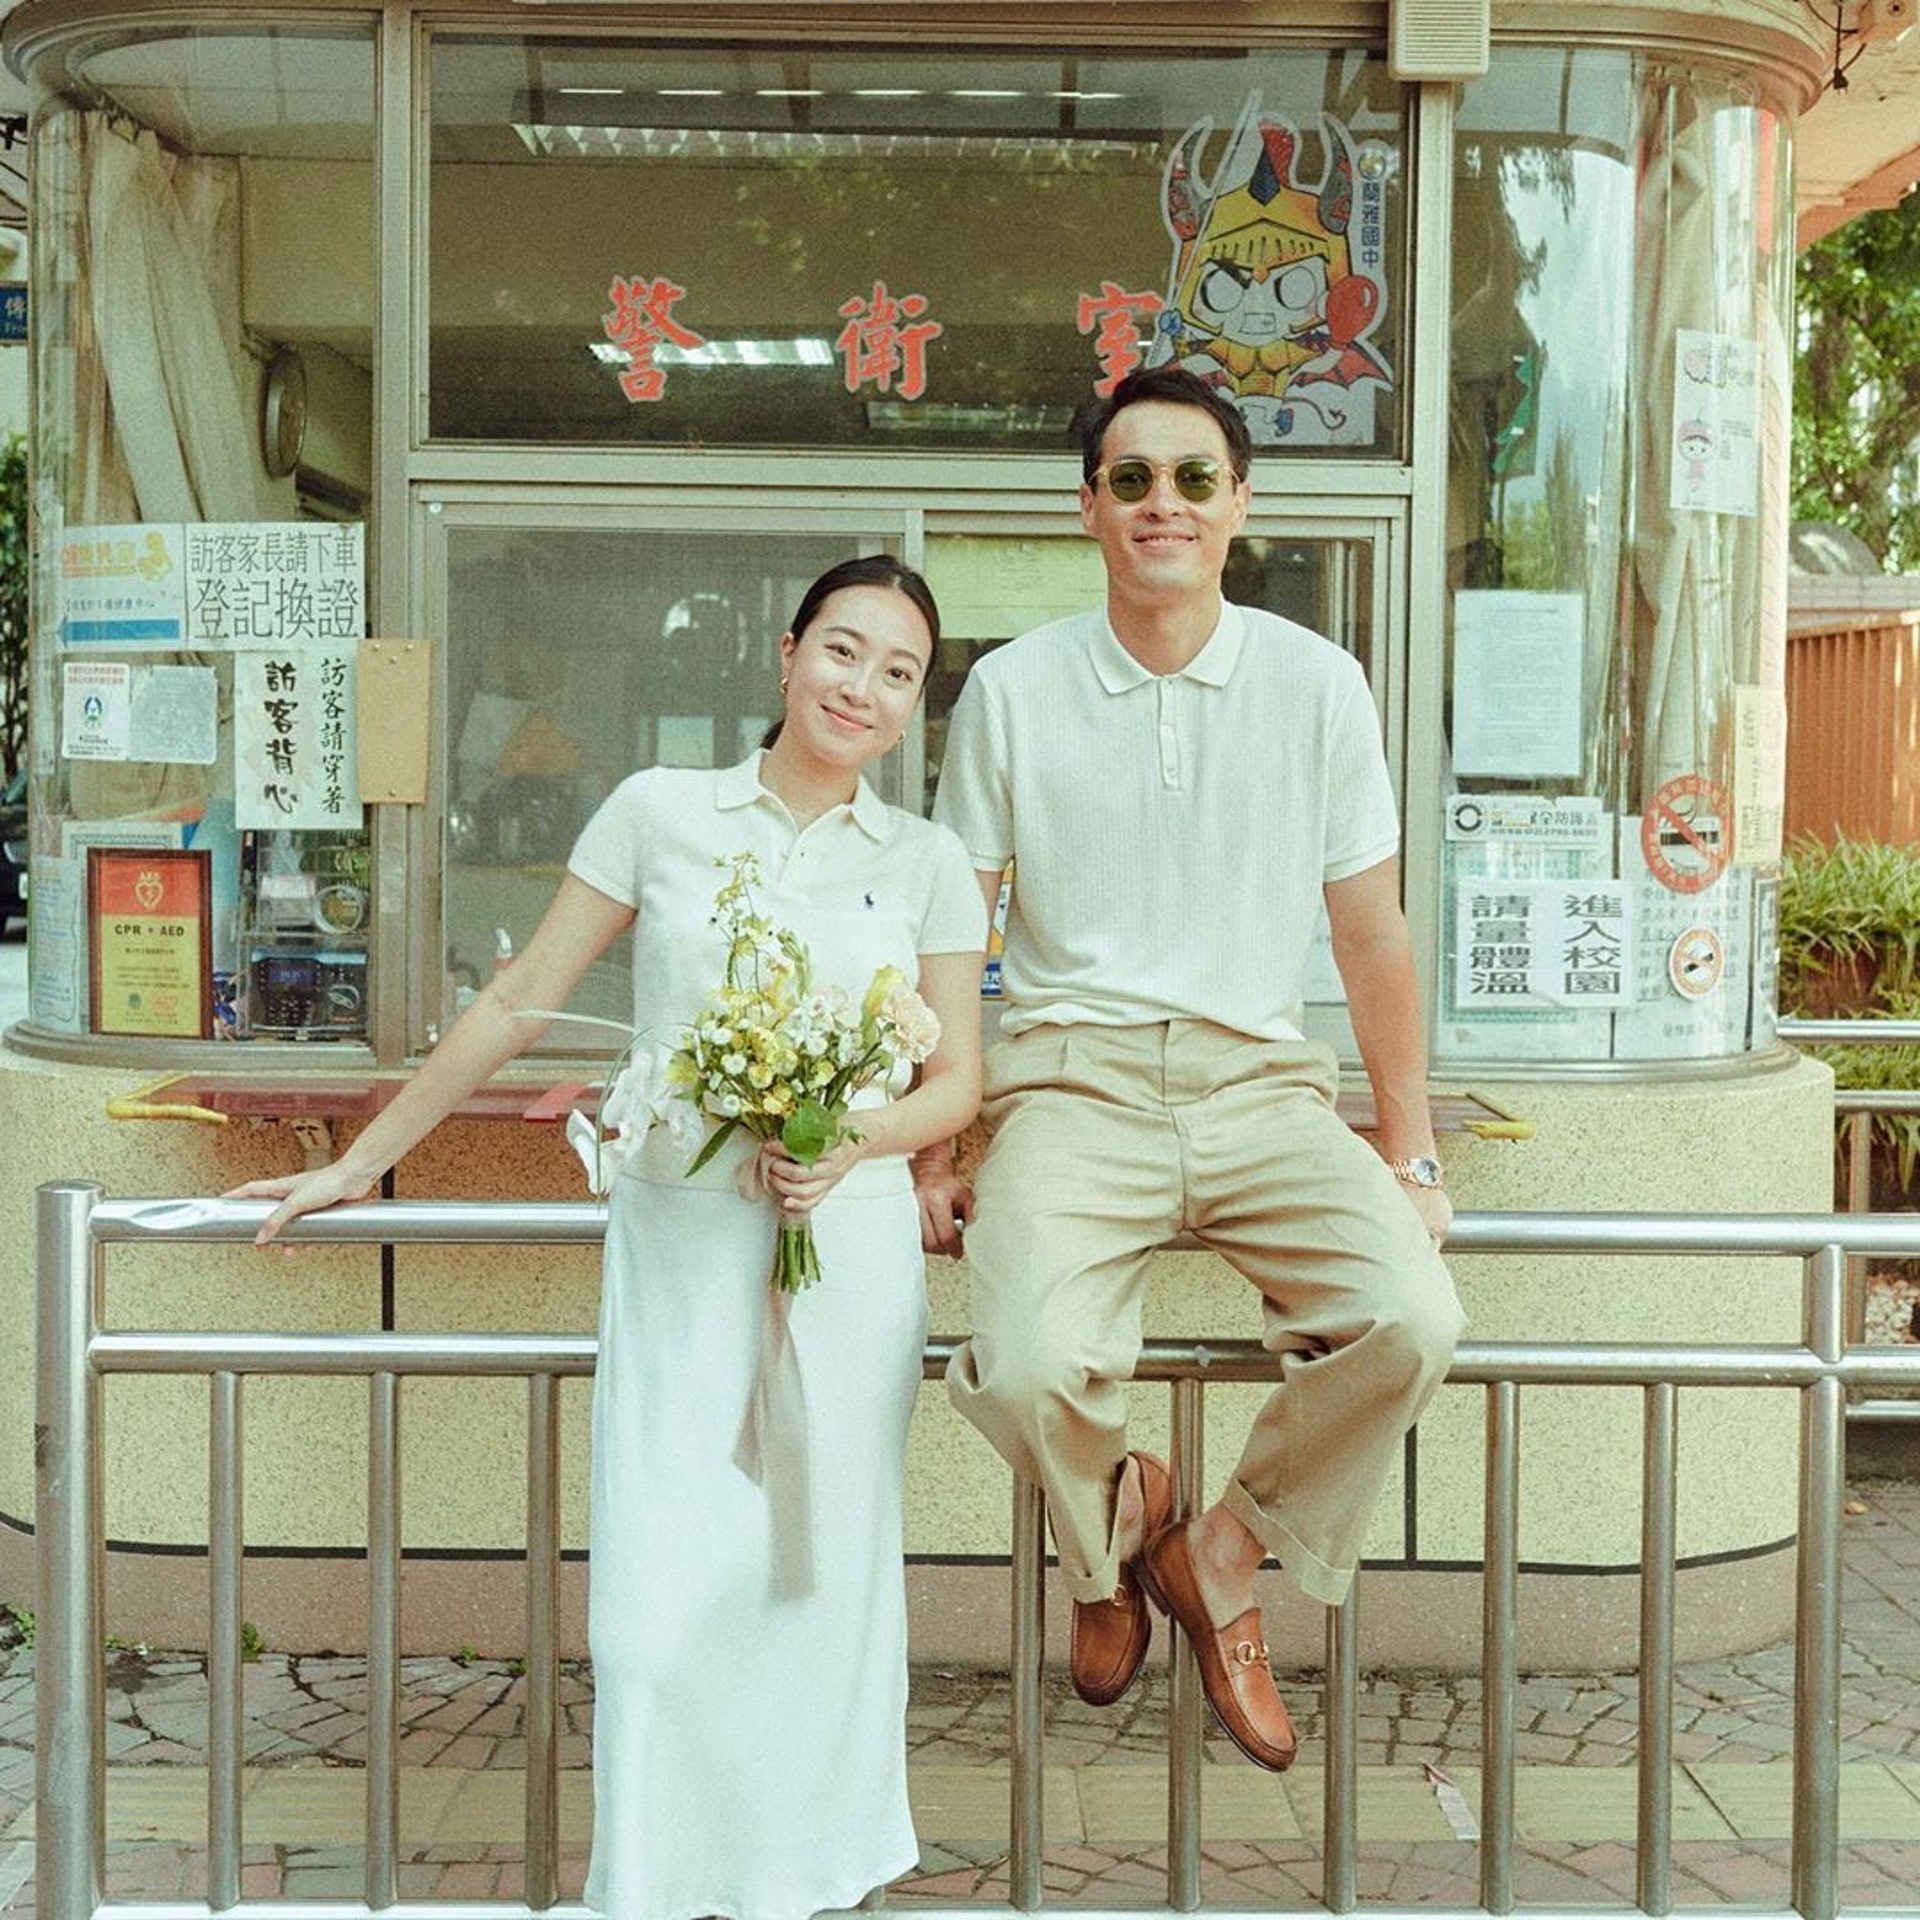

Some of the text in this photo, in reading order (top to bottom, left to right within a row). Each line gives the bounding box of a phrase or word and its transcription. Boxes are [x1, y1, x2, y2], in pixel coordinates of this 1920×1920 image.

[601, 275, 1164, 402] 警衛室
[190, 530, 357, 574] 訪客家長請下車
[193, 576, 359, 640] 登記換證
[264, 660, 299, 814] 訪客背心
[321, 657, 348, 814] 訪客請穿著
[114, 923, 142, 936] CPR
[159, 924, 185, 937] AED
[1469, 894, 1532, 994] 請量體溫
[1563, 894, 1623, 994] 進入校園
